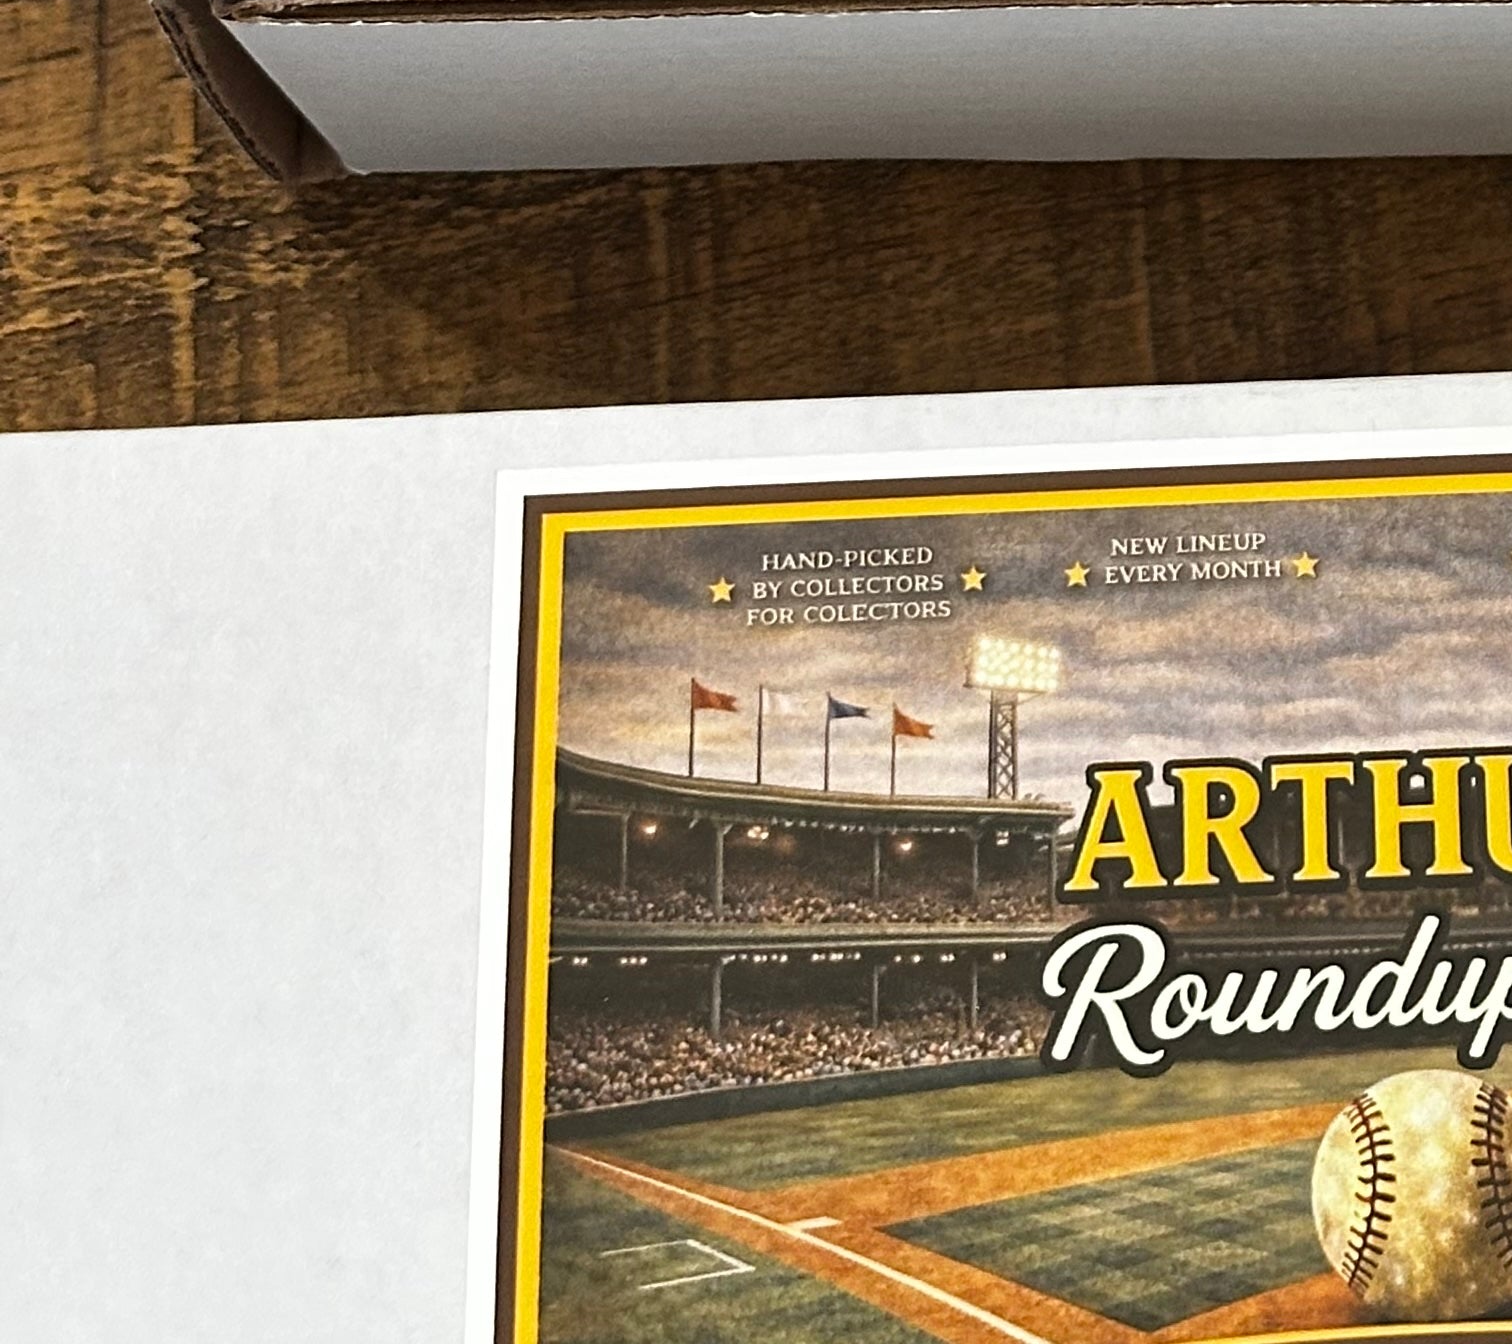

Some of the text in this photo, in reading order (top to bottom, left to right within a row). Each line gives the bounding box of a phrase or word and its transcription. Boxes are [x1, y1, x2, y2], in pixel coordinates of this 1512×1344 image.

[1109, 531, 1267, 557] NEW LINEUP
[762, 546, 934, 573] HAND-PICKED
[1103, 557, 1282, 587] EVERY MONTH
[752, 573, 945, 600] BY COLLECTORS
[746, 598, 952, 627] FOR COLECTORS
